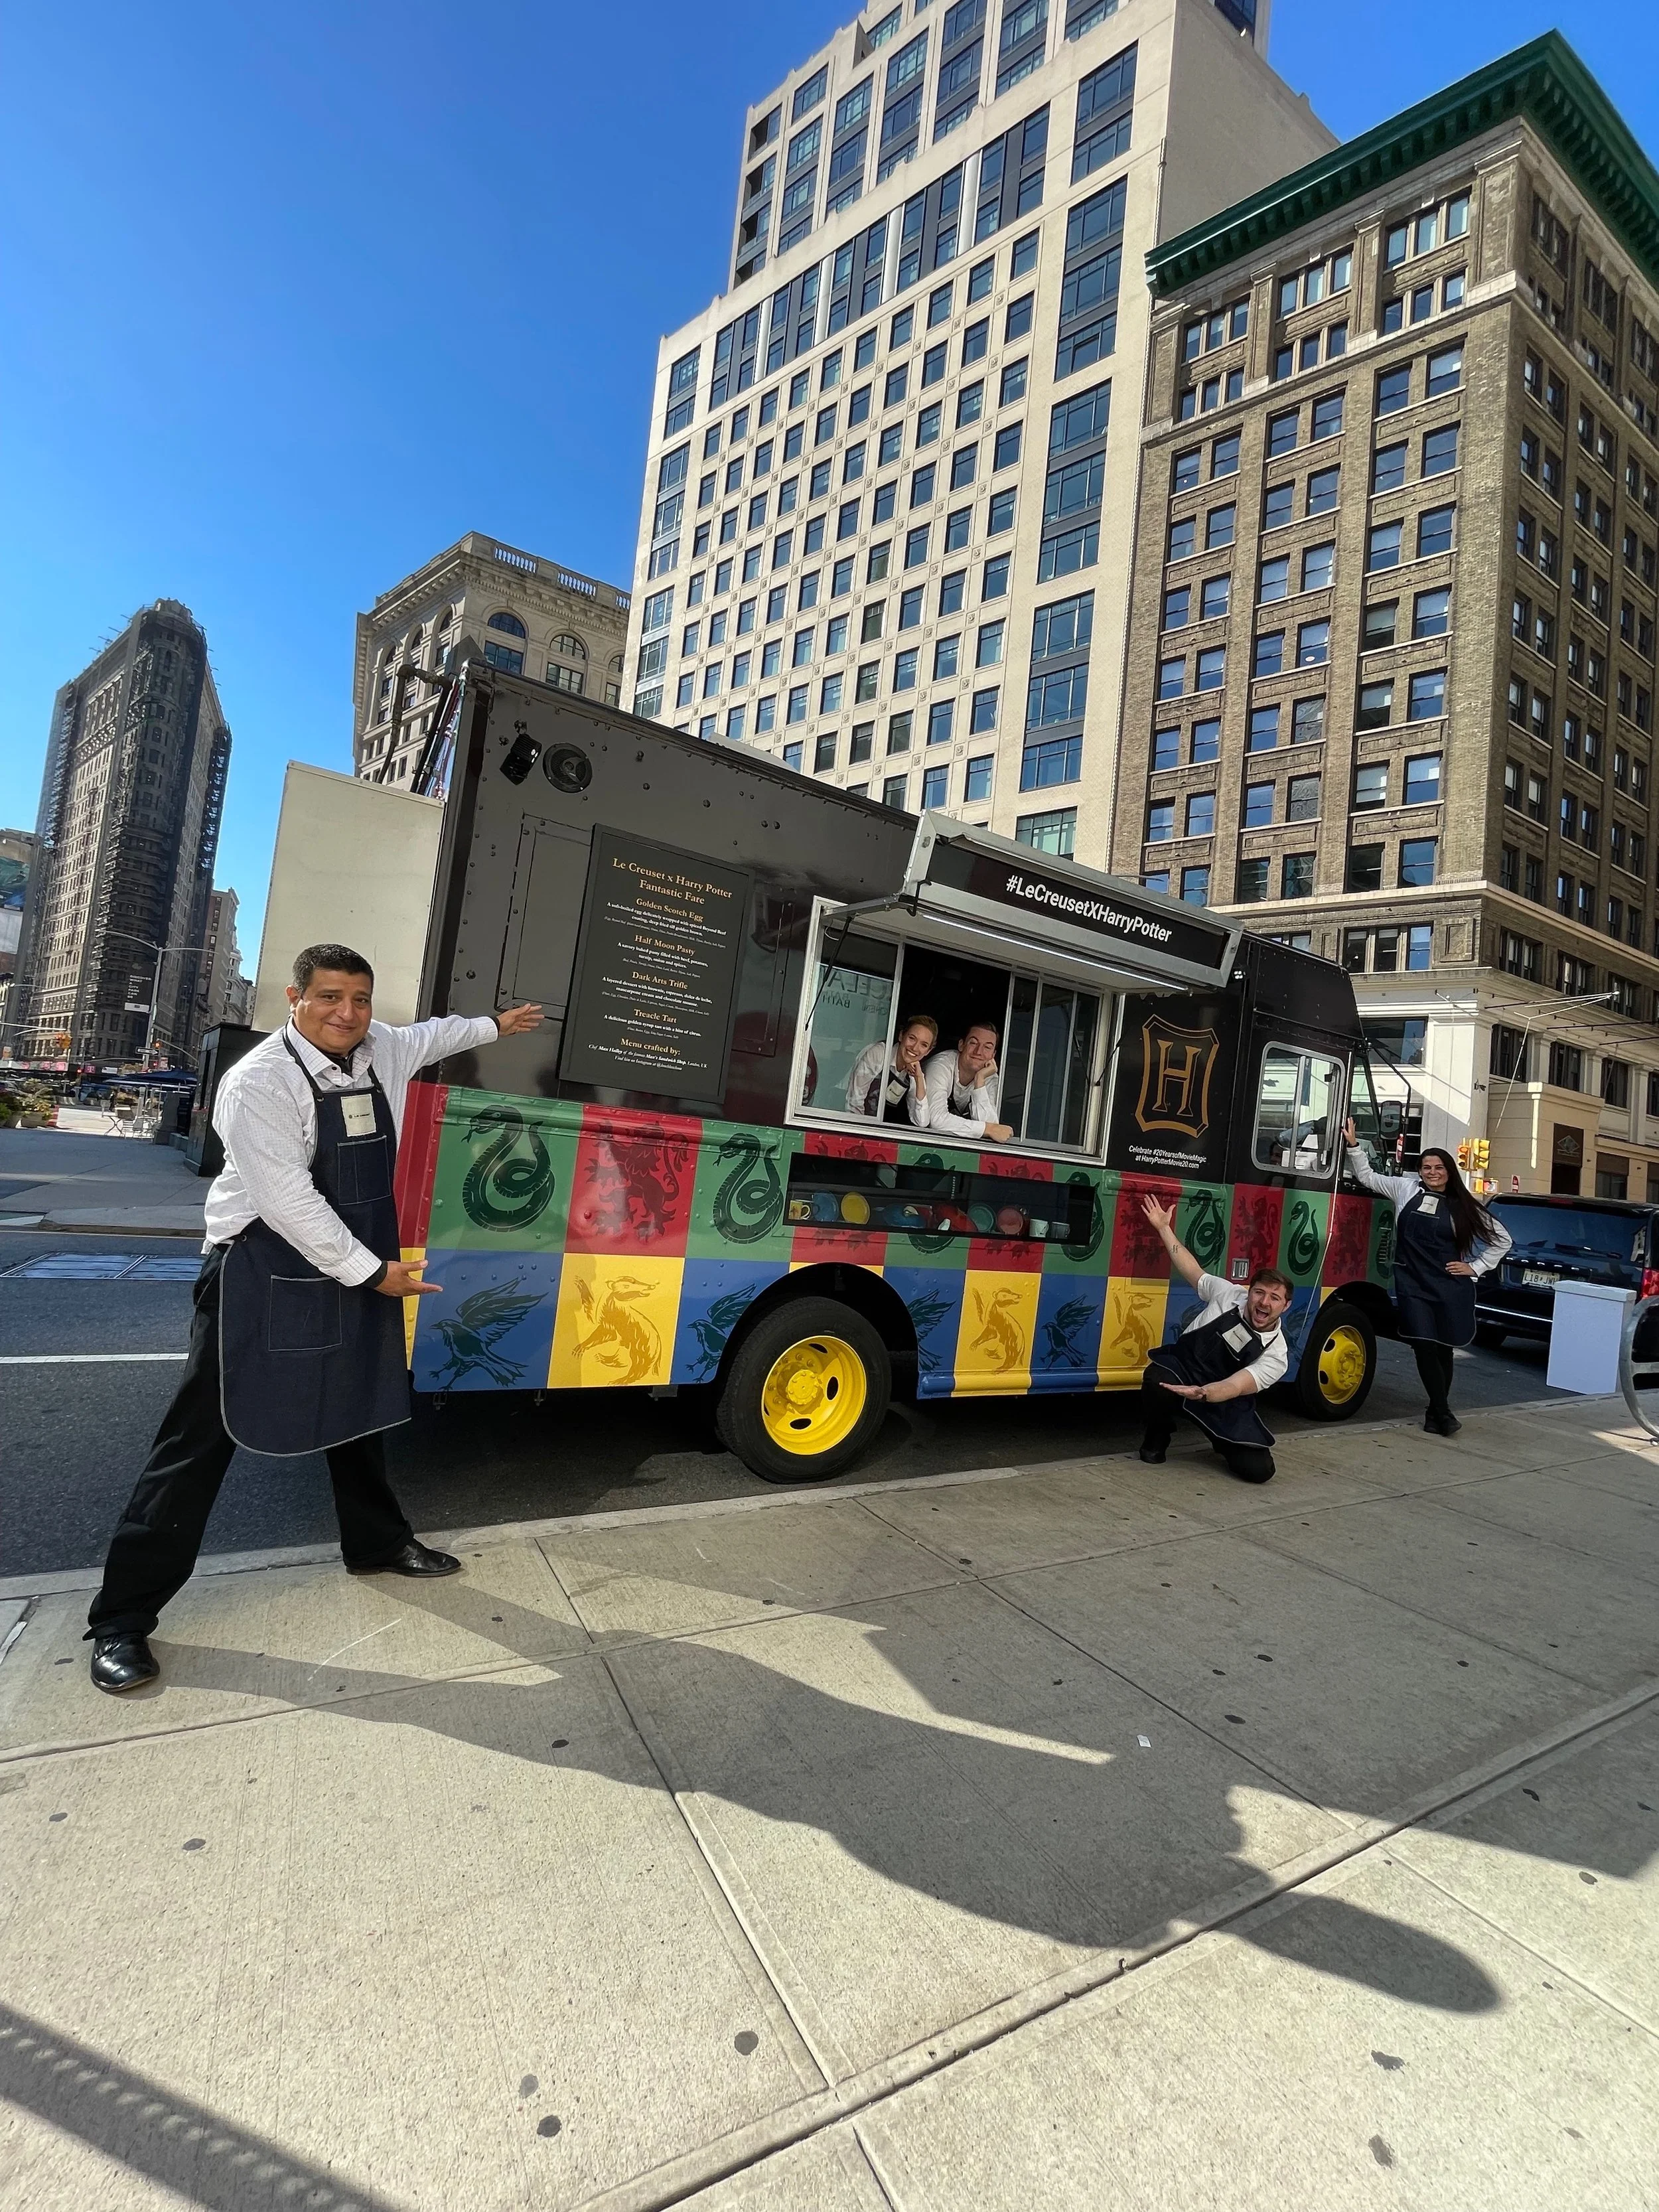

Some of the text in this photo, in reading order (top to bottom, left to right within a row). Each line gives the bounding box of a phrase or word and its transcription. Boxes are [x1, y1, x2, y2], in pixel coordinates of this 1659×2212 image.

[613, 858, 626, 869] Le
[628, 863, 666, 880] Creuset
[676, 875, 703, 893] Harry
[705, 883, 733, 899] Potter
[639, 879, 705, 905] Fantastic Fare
[636, 898, 704, 923] Golden Scotch Egg
[1006, 875, 1173, 942] #LeCreusetXHarryPotter
[634, 934, 695, 957] Half Moon Pasty
[632, 972, 688, 990] Dark Arts Trifle
[634, 1009, 677, 1023] Treacle Tart
[620, 1038, 681, 1057] Menu crafted by:
[1152, 1039, 1202, 1117] H
[1129, 1145, 1207, 1163] Celebrate #20YearsofMovieMagic
[1141, 1155, 1199, 1169] HarryPotterMovie20.com
